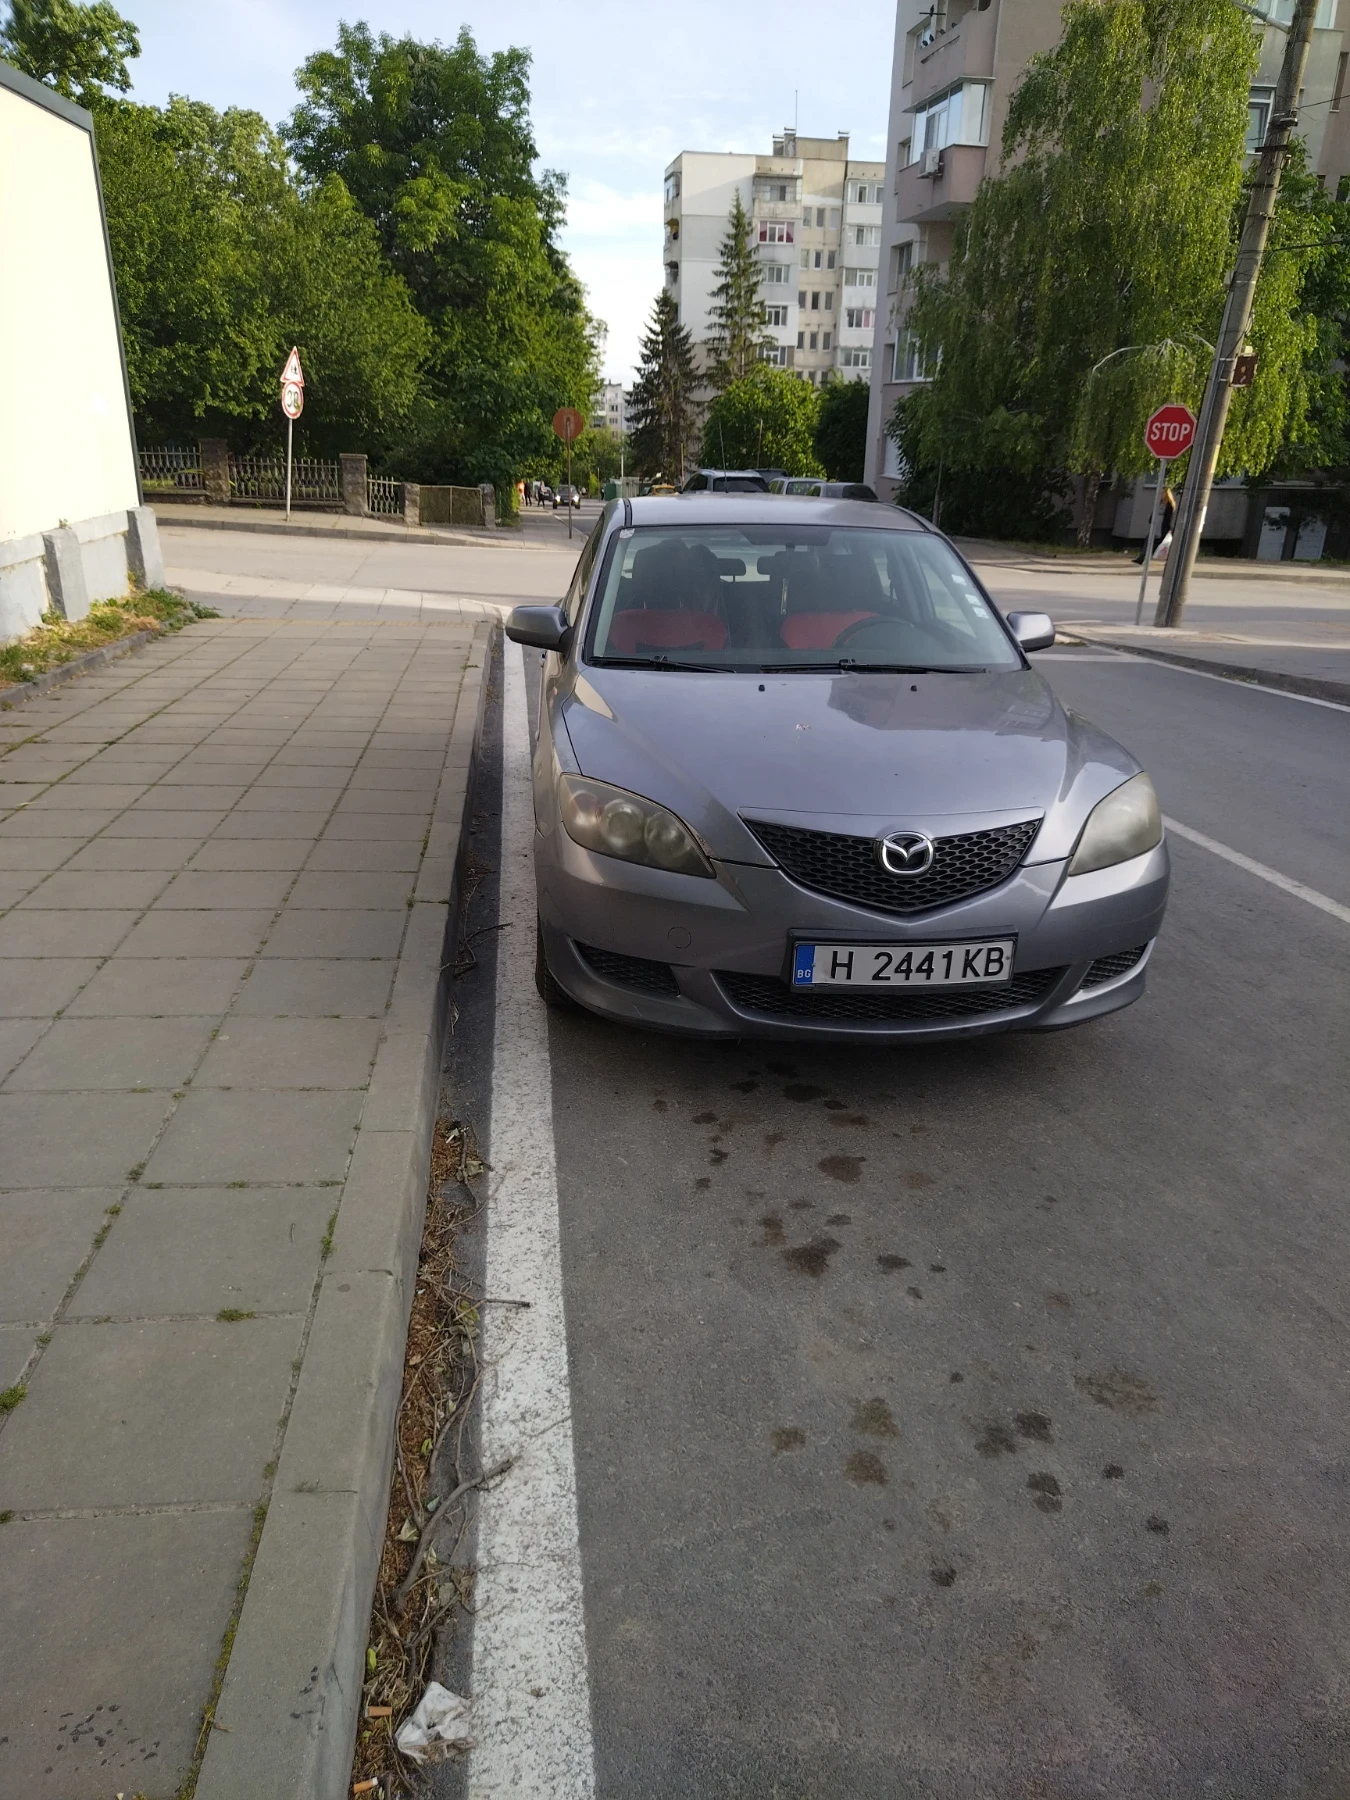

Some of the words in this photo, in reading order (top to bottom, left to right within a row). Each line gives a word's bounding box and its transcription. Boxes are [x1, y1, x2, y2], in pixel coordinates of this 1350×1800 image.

[287, 390, 299, 409] 30
[1150, 422, 1191, 442] STOP
[797, 969, 812, 979] BG
[830, 950, 854, 980] H
